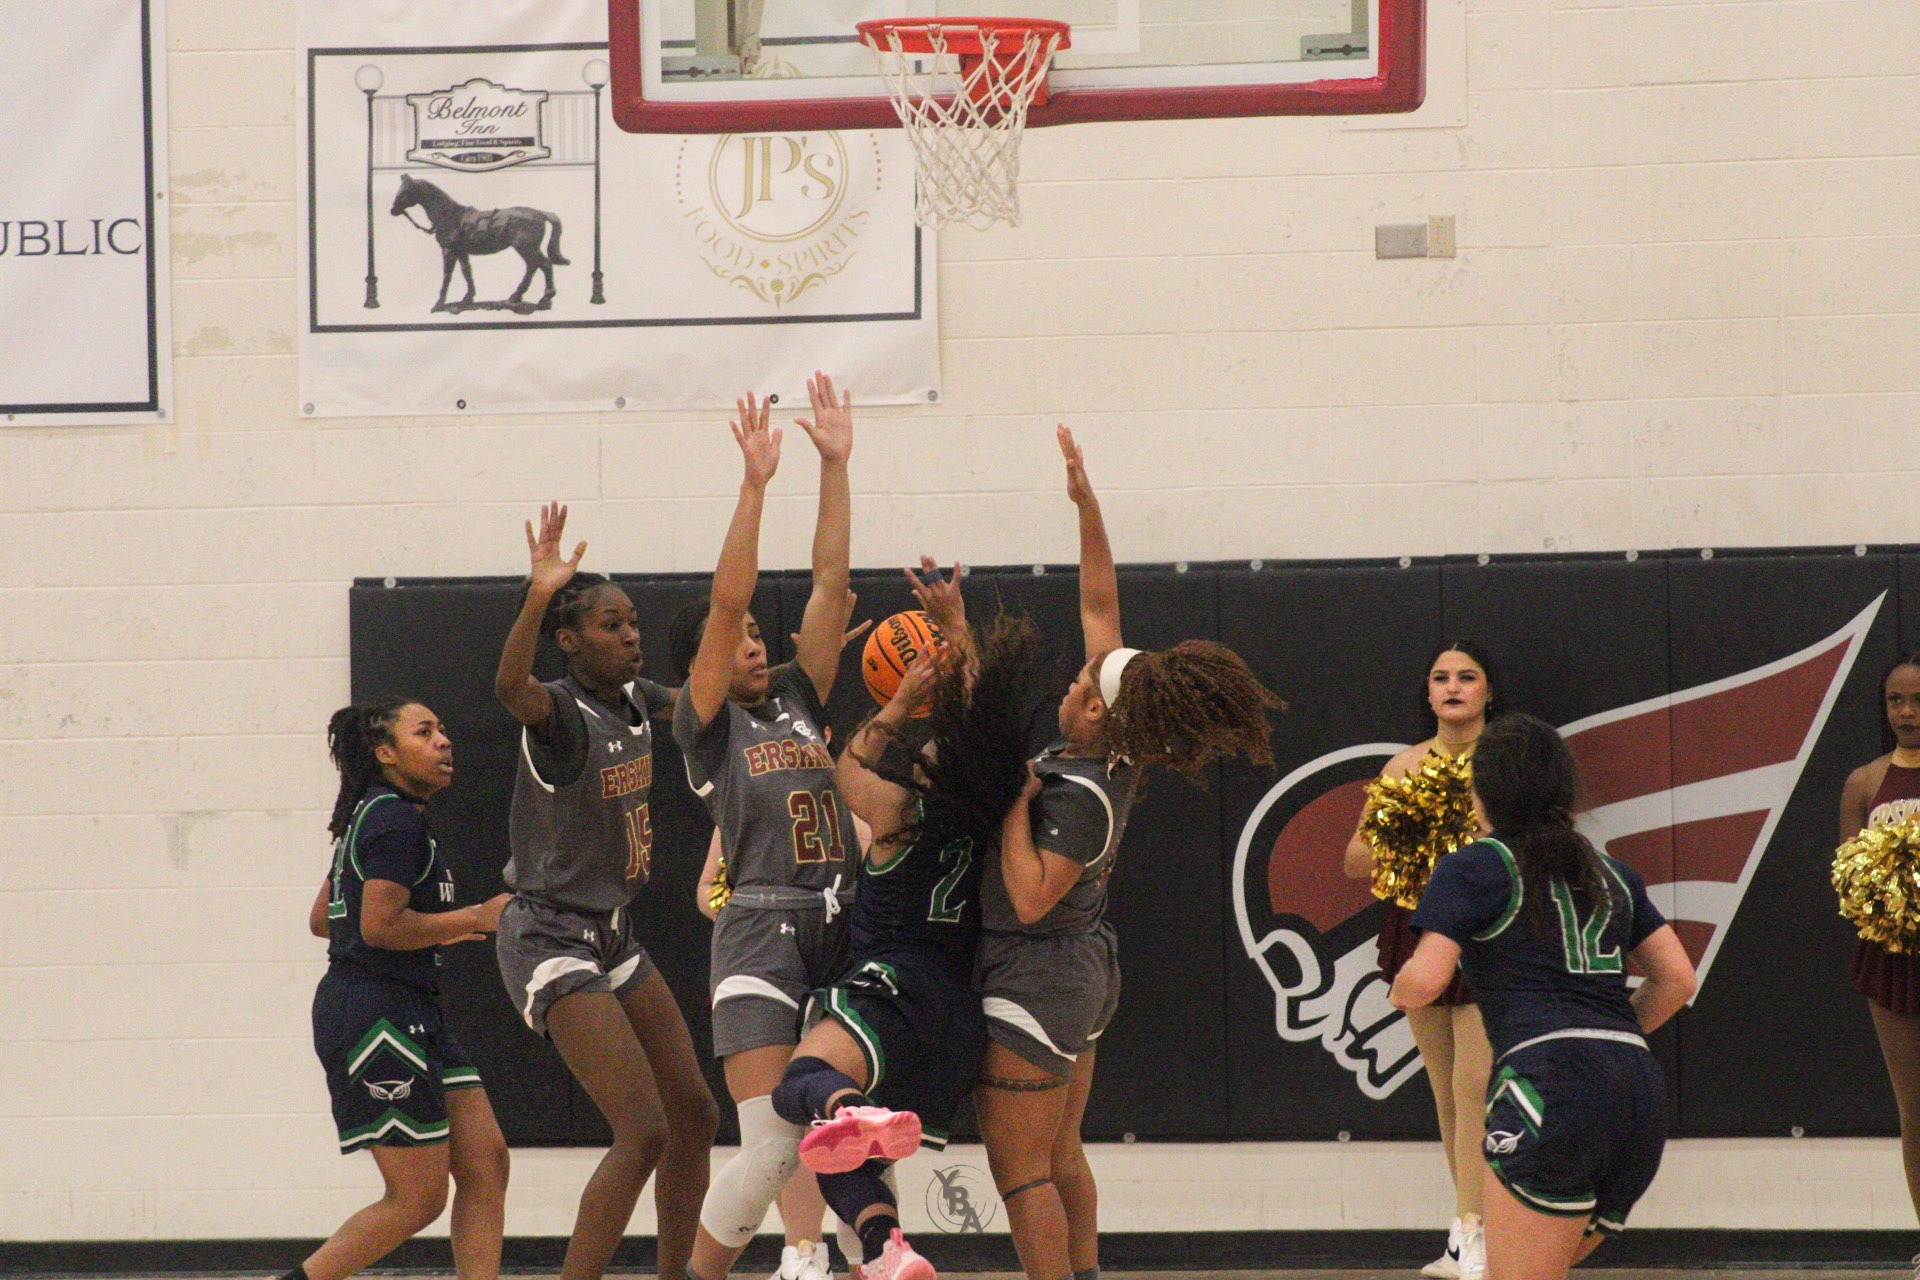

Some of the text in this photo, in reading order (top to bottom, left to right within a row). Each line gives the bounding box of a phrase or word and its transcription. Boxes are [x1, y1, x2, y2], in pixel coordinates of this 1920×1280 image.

[427, 96, 528, 120] Belmont
[455, 118, 500, 135] Inn
[685, 205, 871, 274] FOOD SPIRITS
[787, 790, 845, 864] 21
[927, 836, 973, 923] 2
[1549, 874, 1622, 972] 12
